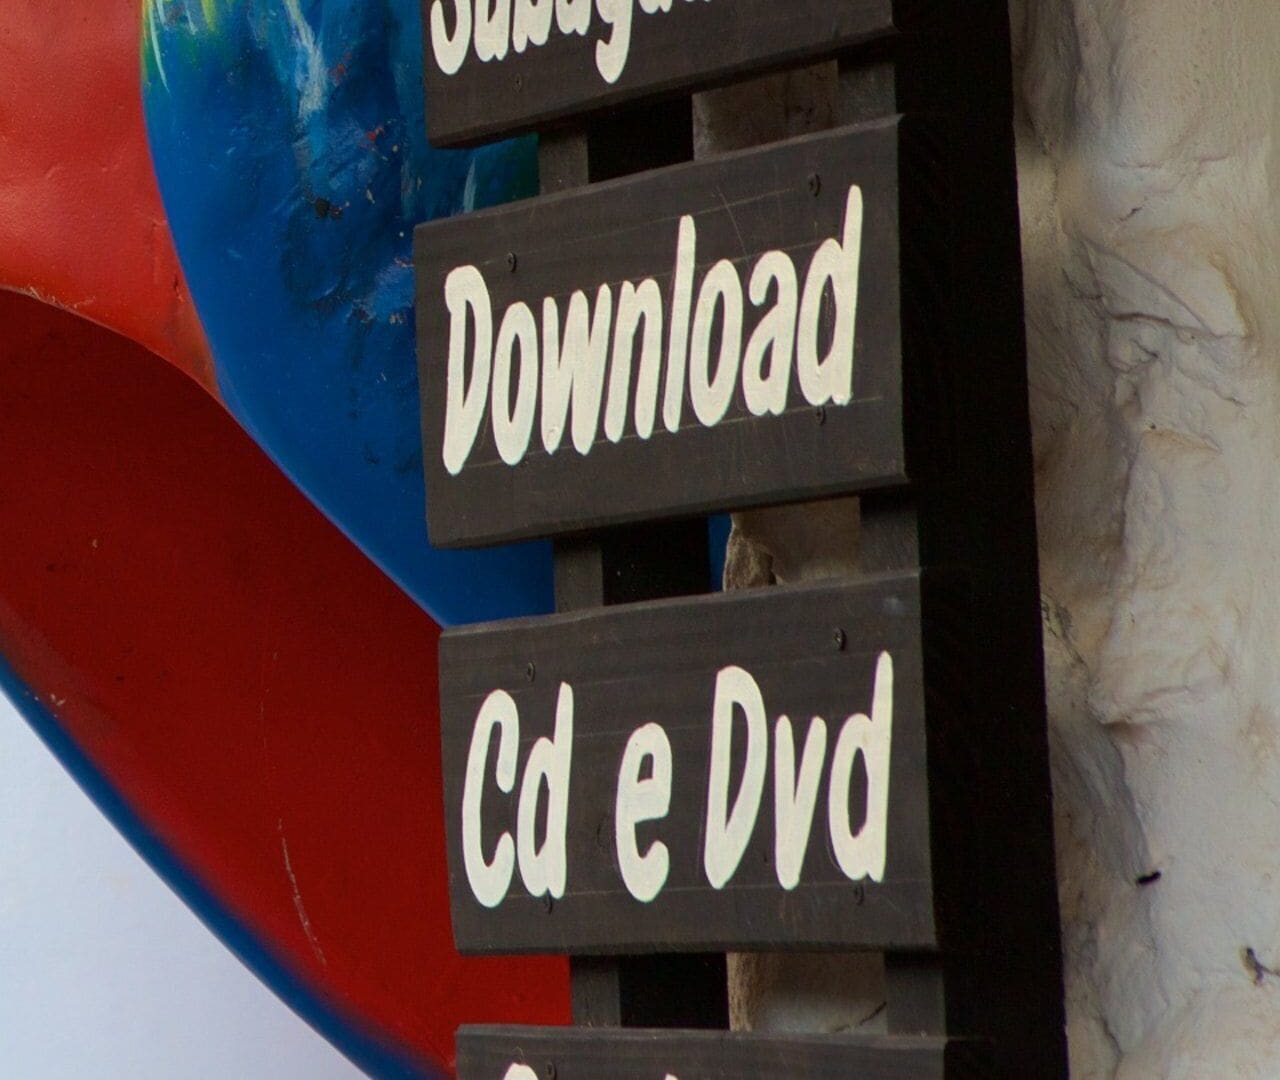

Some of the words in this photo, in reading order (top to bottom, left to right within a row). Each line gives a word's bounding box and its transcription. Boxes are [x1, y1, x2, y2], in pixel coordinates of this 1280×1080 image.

[442, 184, 864, 476] Download
[461, 681, 574, 908] Cd
[615, 722, 673, 903] e
[703, 650, 894, 891] Dvd
